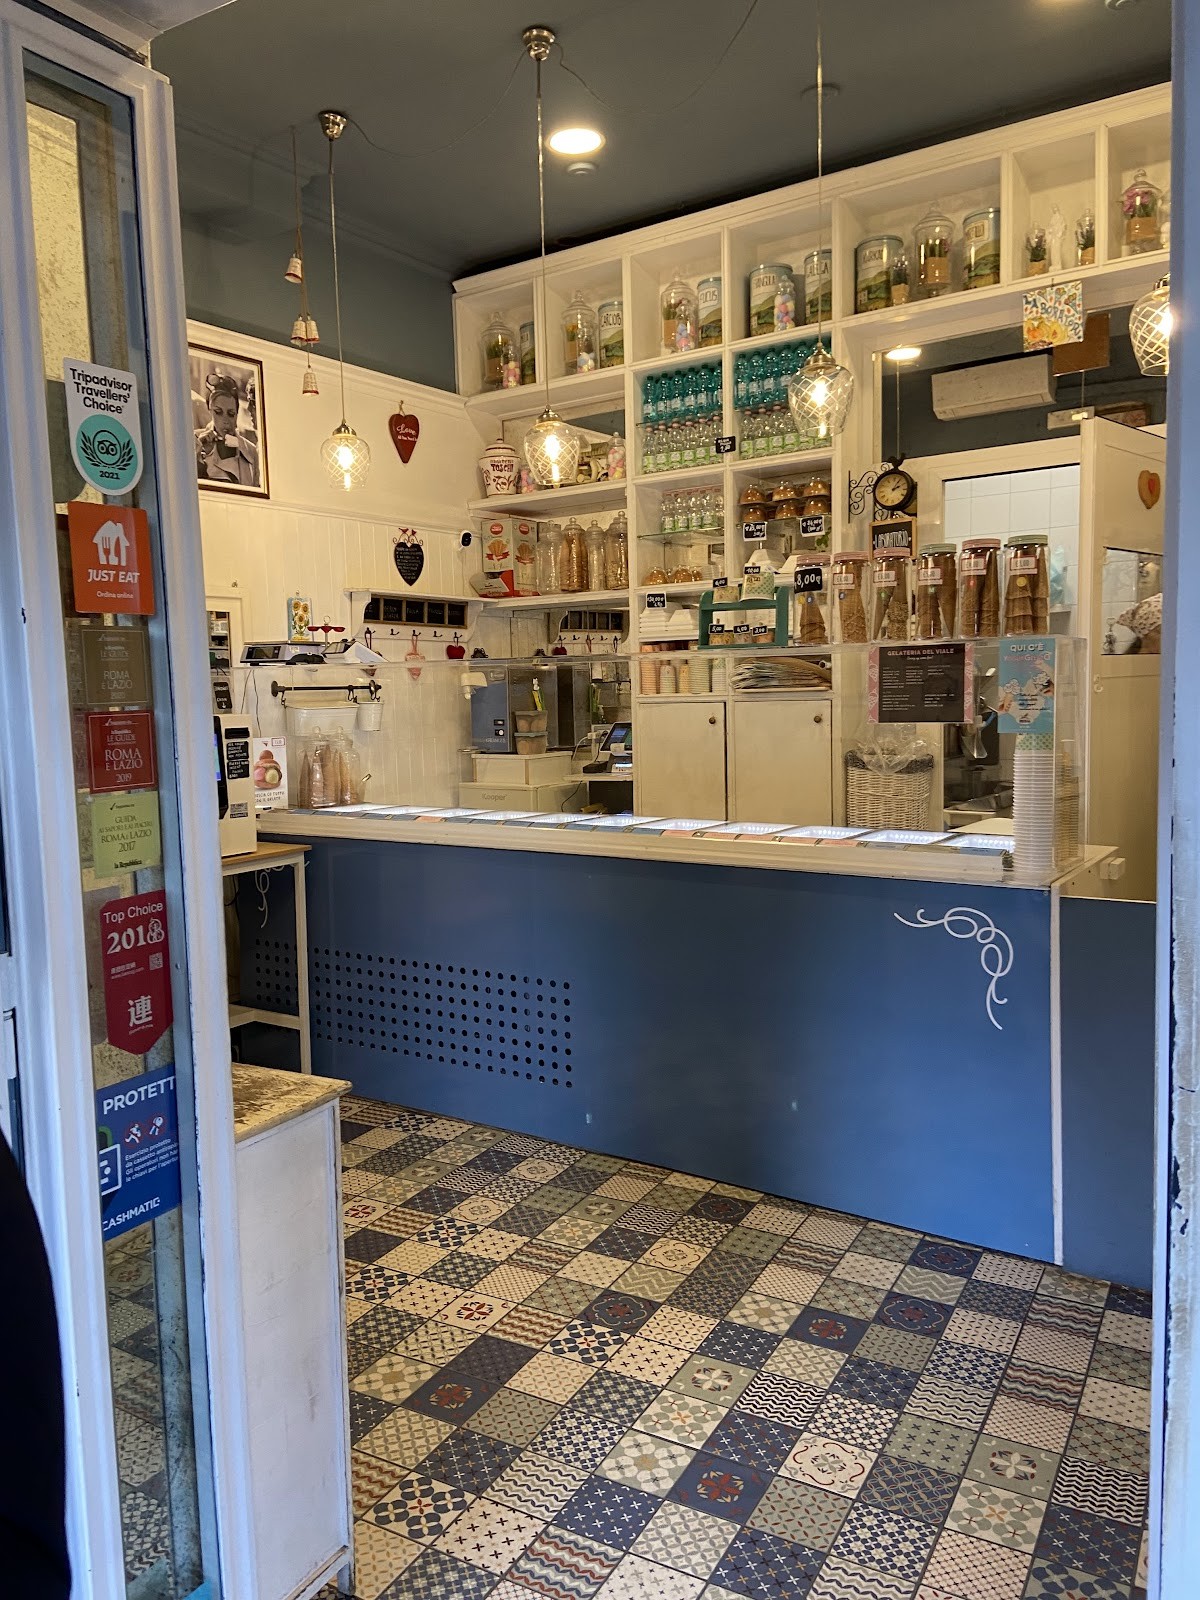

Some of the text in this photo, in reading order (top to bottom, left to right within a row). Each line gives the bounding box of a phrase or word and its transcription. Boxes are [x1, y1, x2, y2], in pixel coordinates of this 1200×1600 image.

[69, 368, 132, 391] Tripadvisor
[73, 382, 130, 403] Travellers'
[83, 397, 121, 413] Choice
[490, 464, 514, 472] TOSCHI
[99, 471, 120, 480] 2021
[87, 569, 140, 583] JUST EAT
[96, 590, 116, 598] Ordina
[1010, 645, 1026, 653] QUI
[103, 670, 130, 680] ROMA
[107, 679, 133, 690] LAZIO
[105, 748, 142, 761] ROMA
[105, 758, 143, 771] E LAZIO
[115, 773, 132, 783] 2019
[101, 833, 125, 843] ROMA
[130, 829, 152, 839] LAZIO
[118, 841, 136, 852] 2017
[103, 902, 163, 924] Top Choice
[106, 918, 165, 955] 2018
[103, 1075, 175, 1115] PROTETT
[125, 1139, 171, 1160] Esercizio protetto
[133, 1152, 156, 1164] cassetto
[134, 1157, 158, 1171] operatori
[132, 1169, 148, 1179] chiavi
[148, 1165, 157, 1173] per
